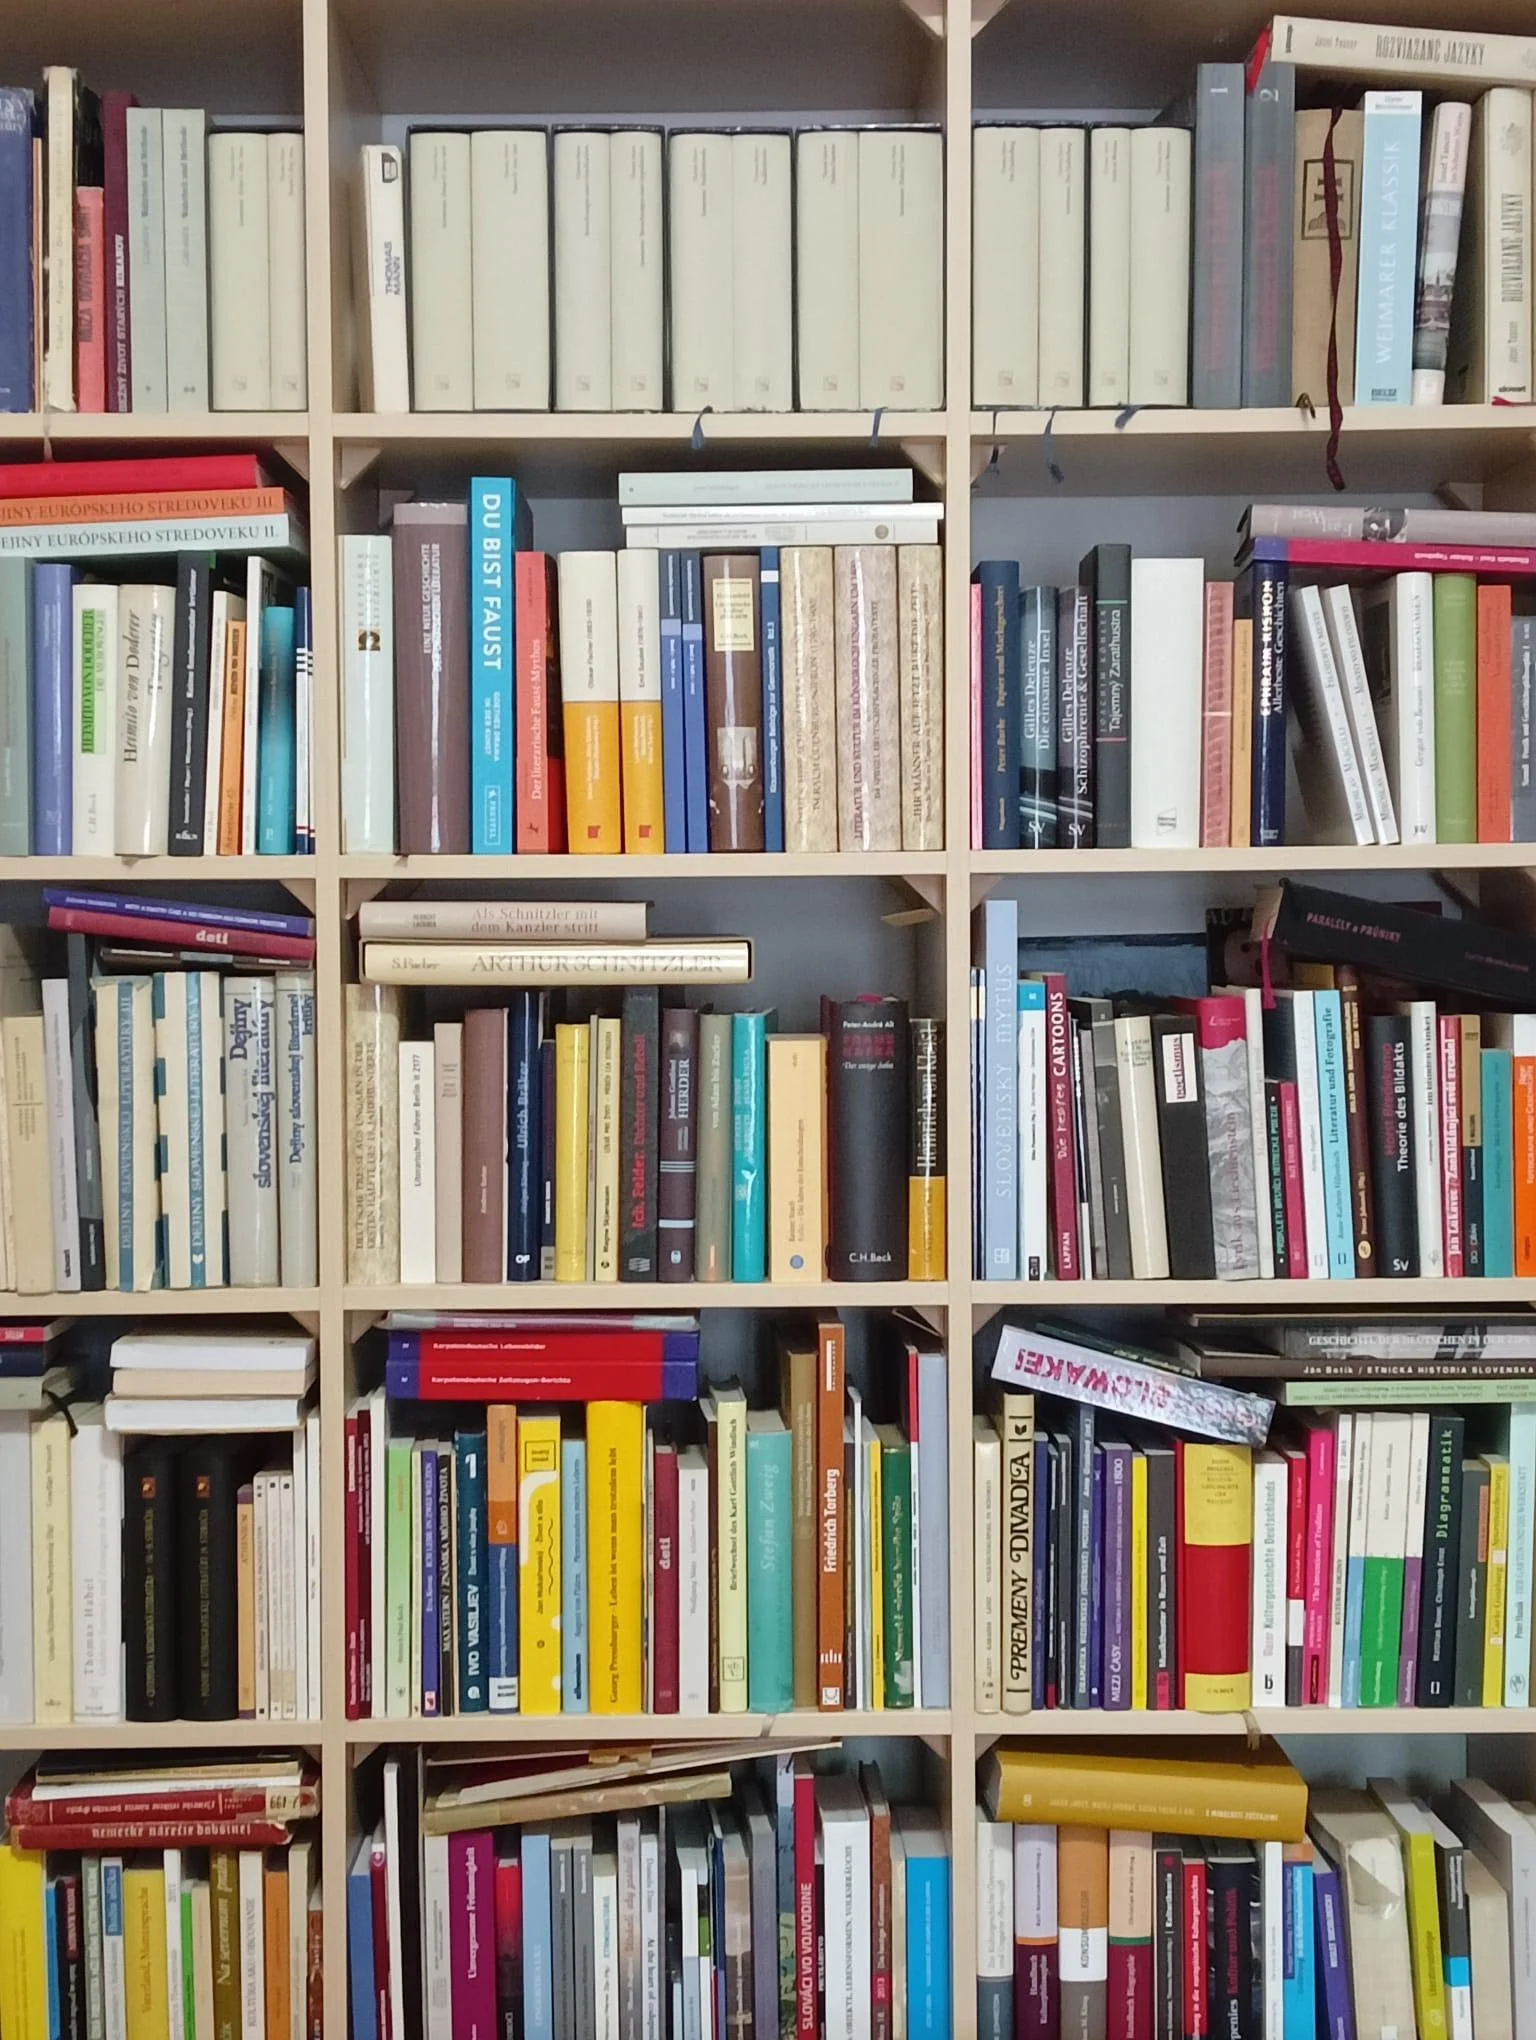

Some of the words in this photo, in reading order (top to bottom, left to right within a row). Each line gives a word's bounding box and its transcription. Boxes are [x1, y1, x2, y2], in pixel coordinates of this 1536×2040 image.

[1381, 140, 1400, 230] KLASSIK
[1375, 243, 1397, 364] WEIMARER
[156, 526, 259, 544] STREDOVEKU
[483, 494, 501, 528] DU
[483, 535, 501, 588] BIST
[124, 610, 141, 669] Doderer
[483, 597, 502, 670] FAUST
[1077, 595, 1089, 679] Gesellschaft
[1109, 609, 1121, 677] Zarathustra
[1274, 581, 1285, 653] Geschichten
[1024, 640, 1036, 696] Deleuze
[1039, 629, 1051, 663] Insel
[125, 675, 139, 700] von
[1040, 666, 1051, 724] einsame
[1063, 648, 1074, 701] Deleuze
[1274, 657, 1284, 713] Allerbeste
[1024, 698, 1036, 739] Gilles
[1062, 704, 1073, 743] Gilles
[1109, 681, 1124, 731] Tajemný
[122, 706, 139, 763] Heimito
[1039, 726, 1051, 749] Die
[1077, 696, 1090, 795] Schizophrenie
[471, 921, 502, 933] dem
[505, 921, 559, 934] Kanzler
[499, 907, 572, 921] Schnitzler
[230, 999, 251, 1060] Dejiny
[301, 995, 313, 1035] kritiky
[1050, 991, 1067, 1076] CARTOONS
[1322, 1007, 1336, 1065] Fotografie
[678, 1058, 690, 1118] HERDER
[1170, 1036, 1187, 1100] poetismus
[1326, 1069, 1336, 1090] und
[1382, 1042, 1397, 1117] Bredekamp
[1394, 1042, 1407, 1094] Bildakts
[412, 1083, 421, 1107] Berlin
[711, 1083, 720, 1109] Adam
[1327, 1094, 1340, 1143] Literatur
[1396, 1097, 1408, 1118] des
[252, 1091, 275, 1188] slovenskej
[289, 1123, 305, 1163] Dejiny
[517, 1109, 528, 1148] Ulrich
[1383, 1120, 1396, 1155] Horst
[1397, 1122, 1409, 1171] Theorie
[1062, 1232, 1073, 1268] LAPPAN
[760, 1464, 779, 1513] Zweig
[824, 1468, 840, 1516] Torberg
[1008, 1452, 1030, 1563] DIVADLA
[1436, 1429, 1452, 1538] Diagrammatik
[1264, 1481, 1277, 1544] Deutschlands
[760, 1519, 775, 1573] Stefan
[823, 1518, 837, 1572] Friedrich
[467, 1584, 480, 1647] VASILJEV
[608, 1576, 617, 1607] Leben
[83, 1624, 95, 1676] Thomas
[1011, 1569, 1028, 1680] PREMENY
[468, 1652, 480, 1676] IVO
[608, 1674, 620, 1703] Georg
[1110, 1674, 1121, 1702] MEZI
[800, 1883, 813, 1954] VOJVODINE
[801, 1957, 813, 1973] VO
[800, 1976, 813, 2030] SLOVÁCI
